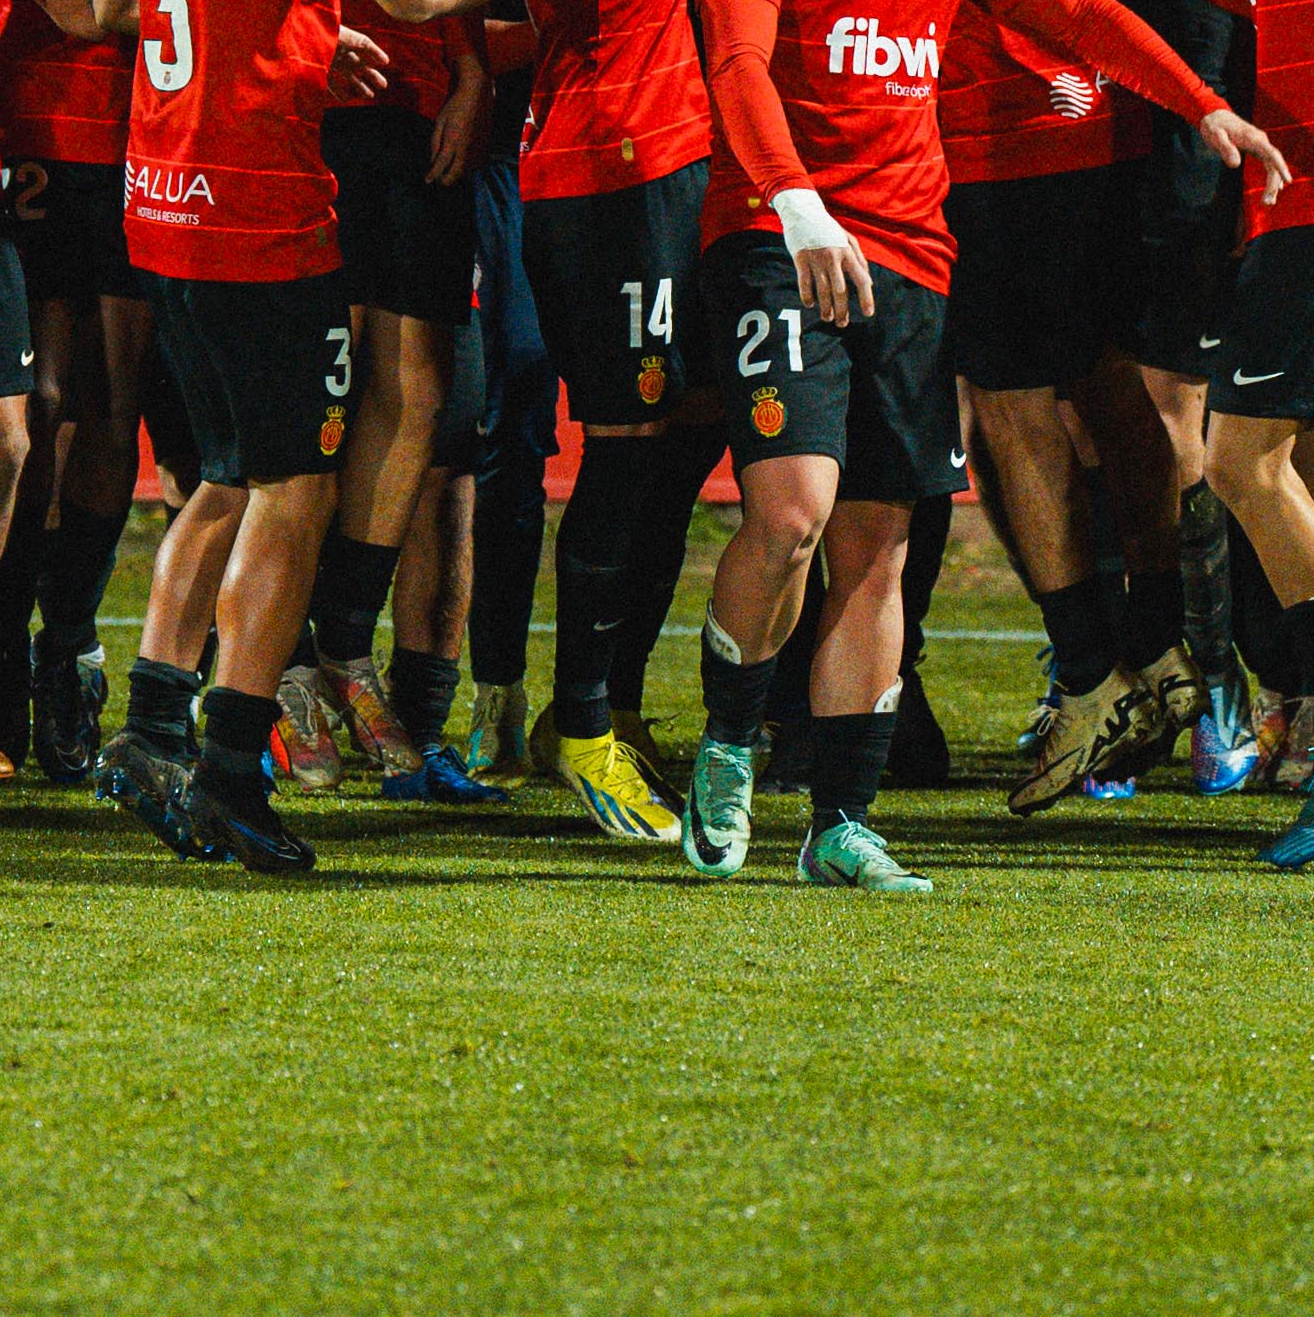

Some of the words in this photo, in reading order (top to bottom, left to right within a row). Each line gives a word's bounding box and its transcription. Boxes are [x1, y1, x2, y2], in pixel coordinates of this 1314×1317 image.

[134, 165, 216, 206] ALUA
[620, 277, 674, 348] 14
[736, 308, 804, 378] 21
[325, 327, 352, 397] 3
